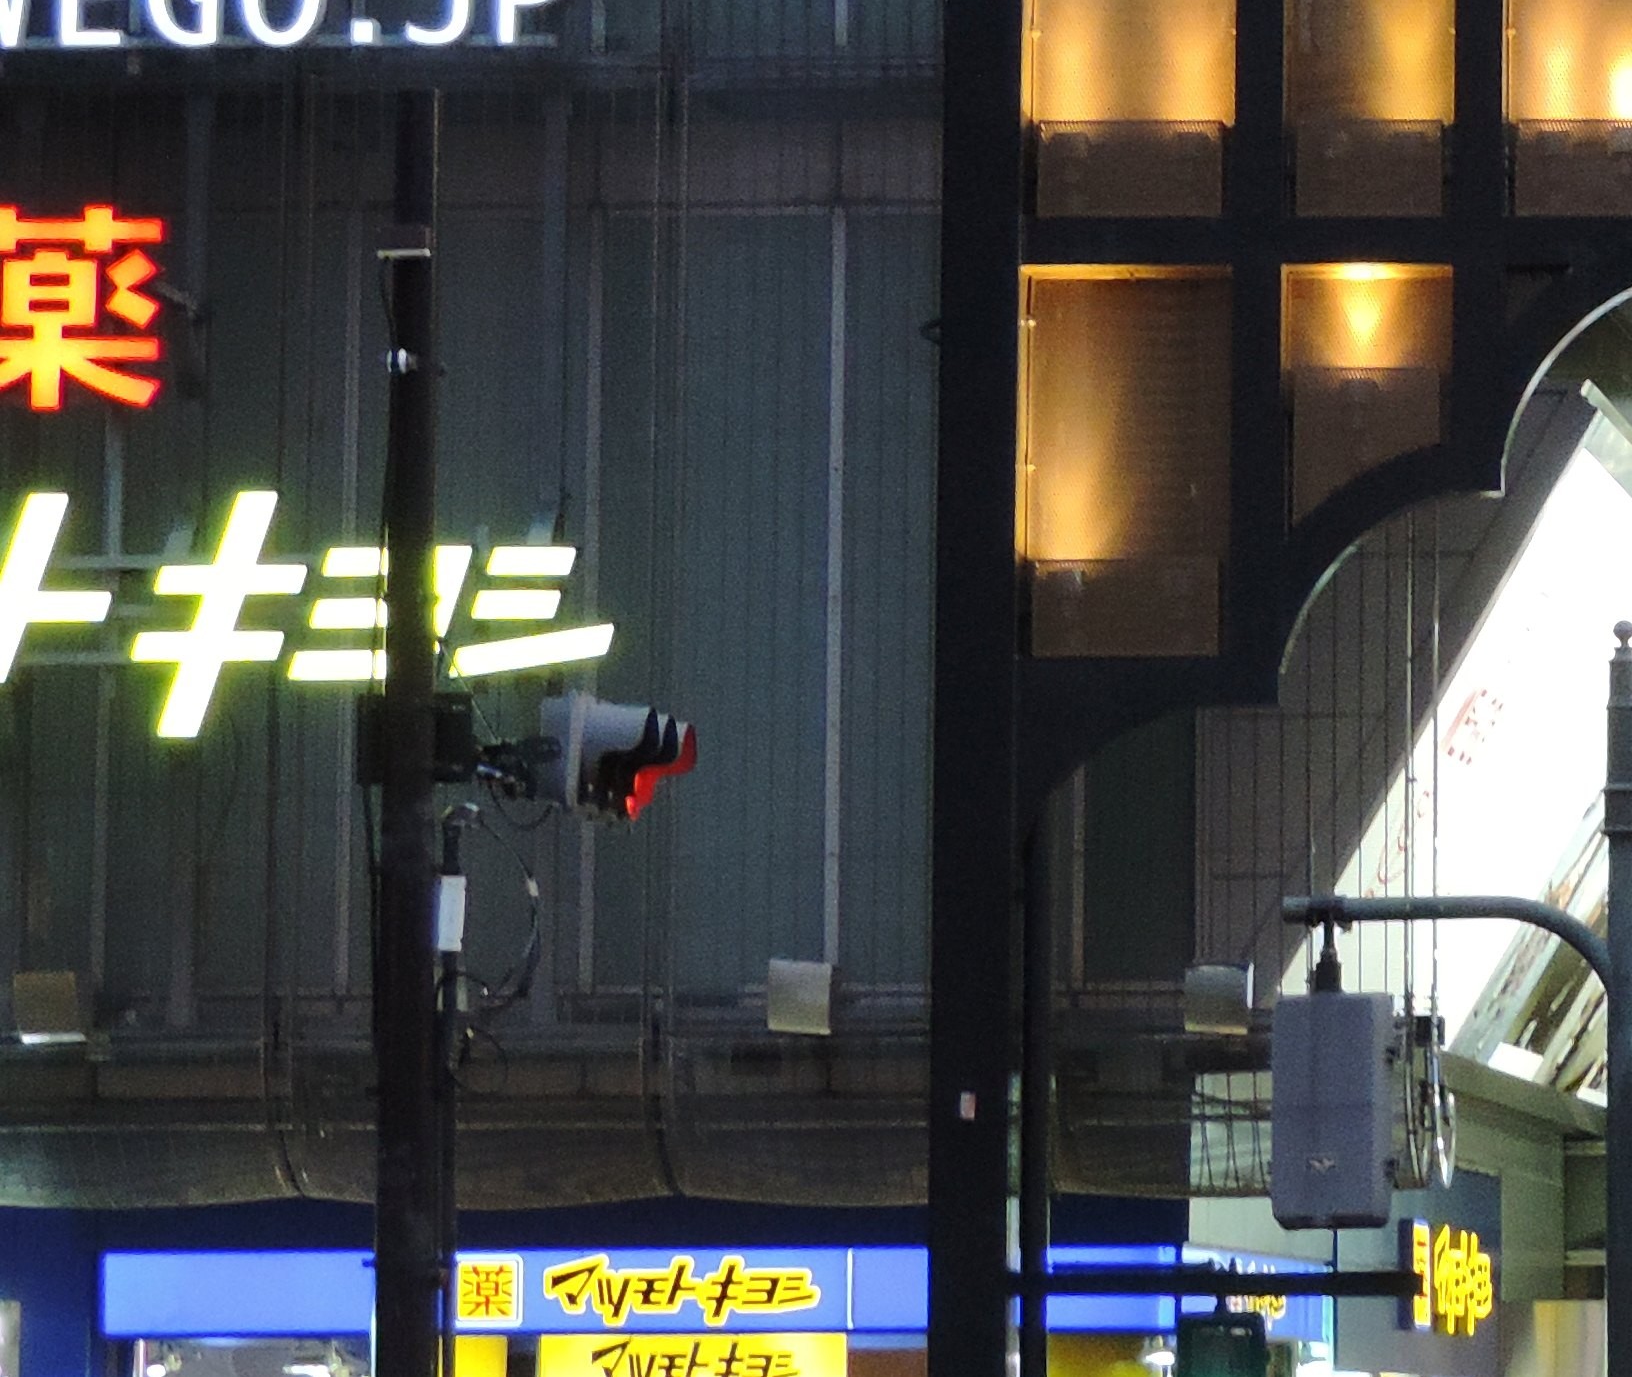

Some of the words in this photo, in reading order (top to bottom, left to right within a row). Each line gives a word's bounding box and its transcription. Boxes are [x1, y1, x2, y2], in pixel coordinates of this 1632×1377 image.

[0, 205, 166, 410] 薬
[462, 1264, 514, 1318] 薬
[550, 1261, 814, 1318] マツモトキヨシ
